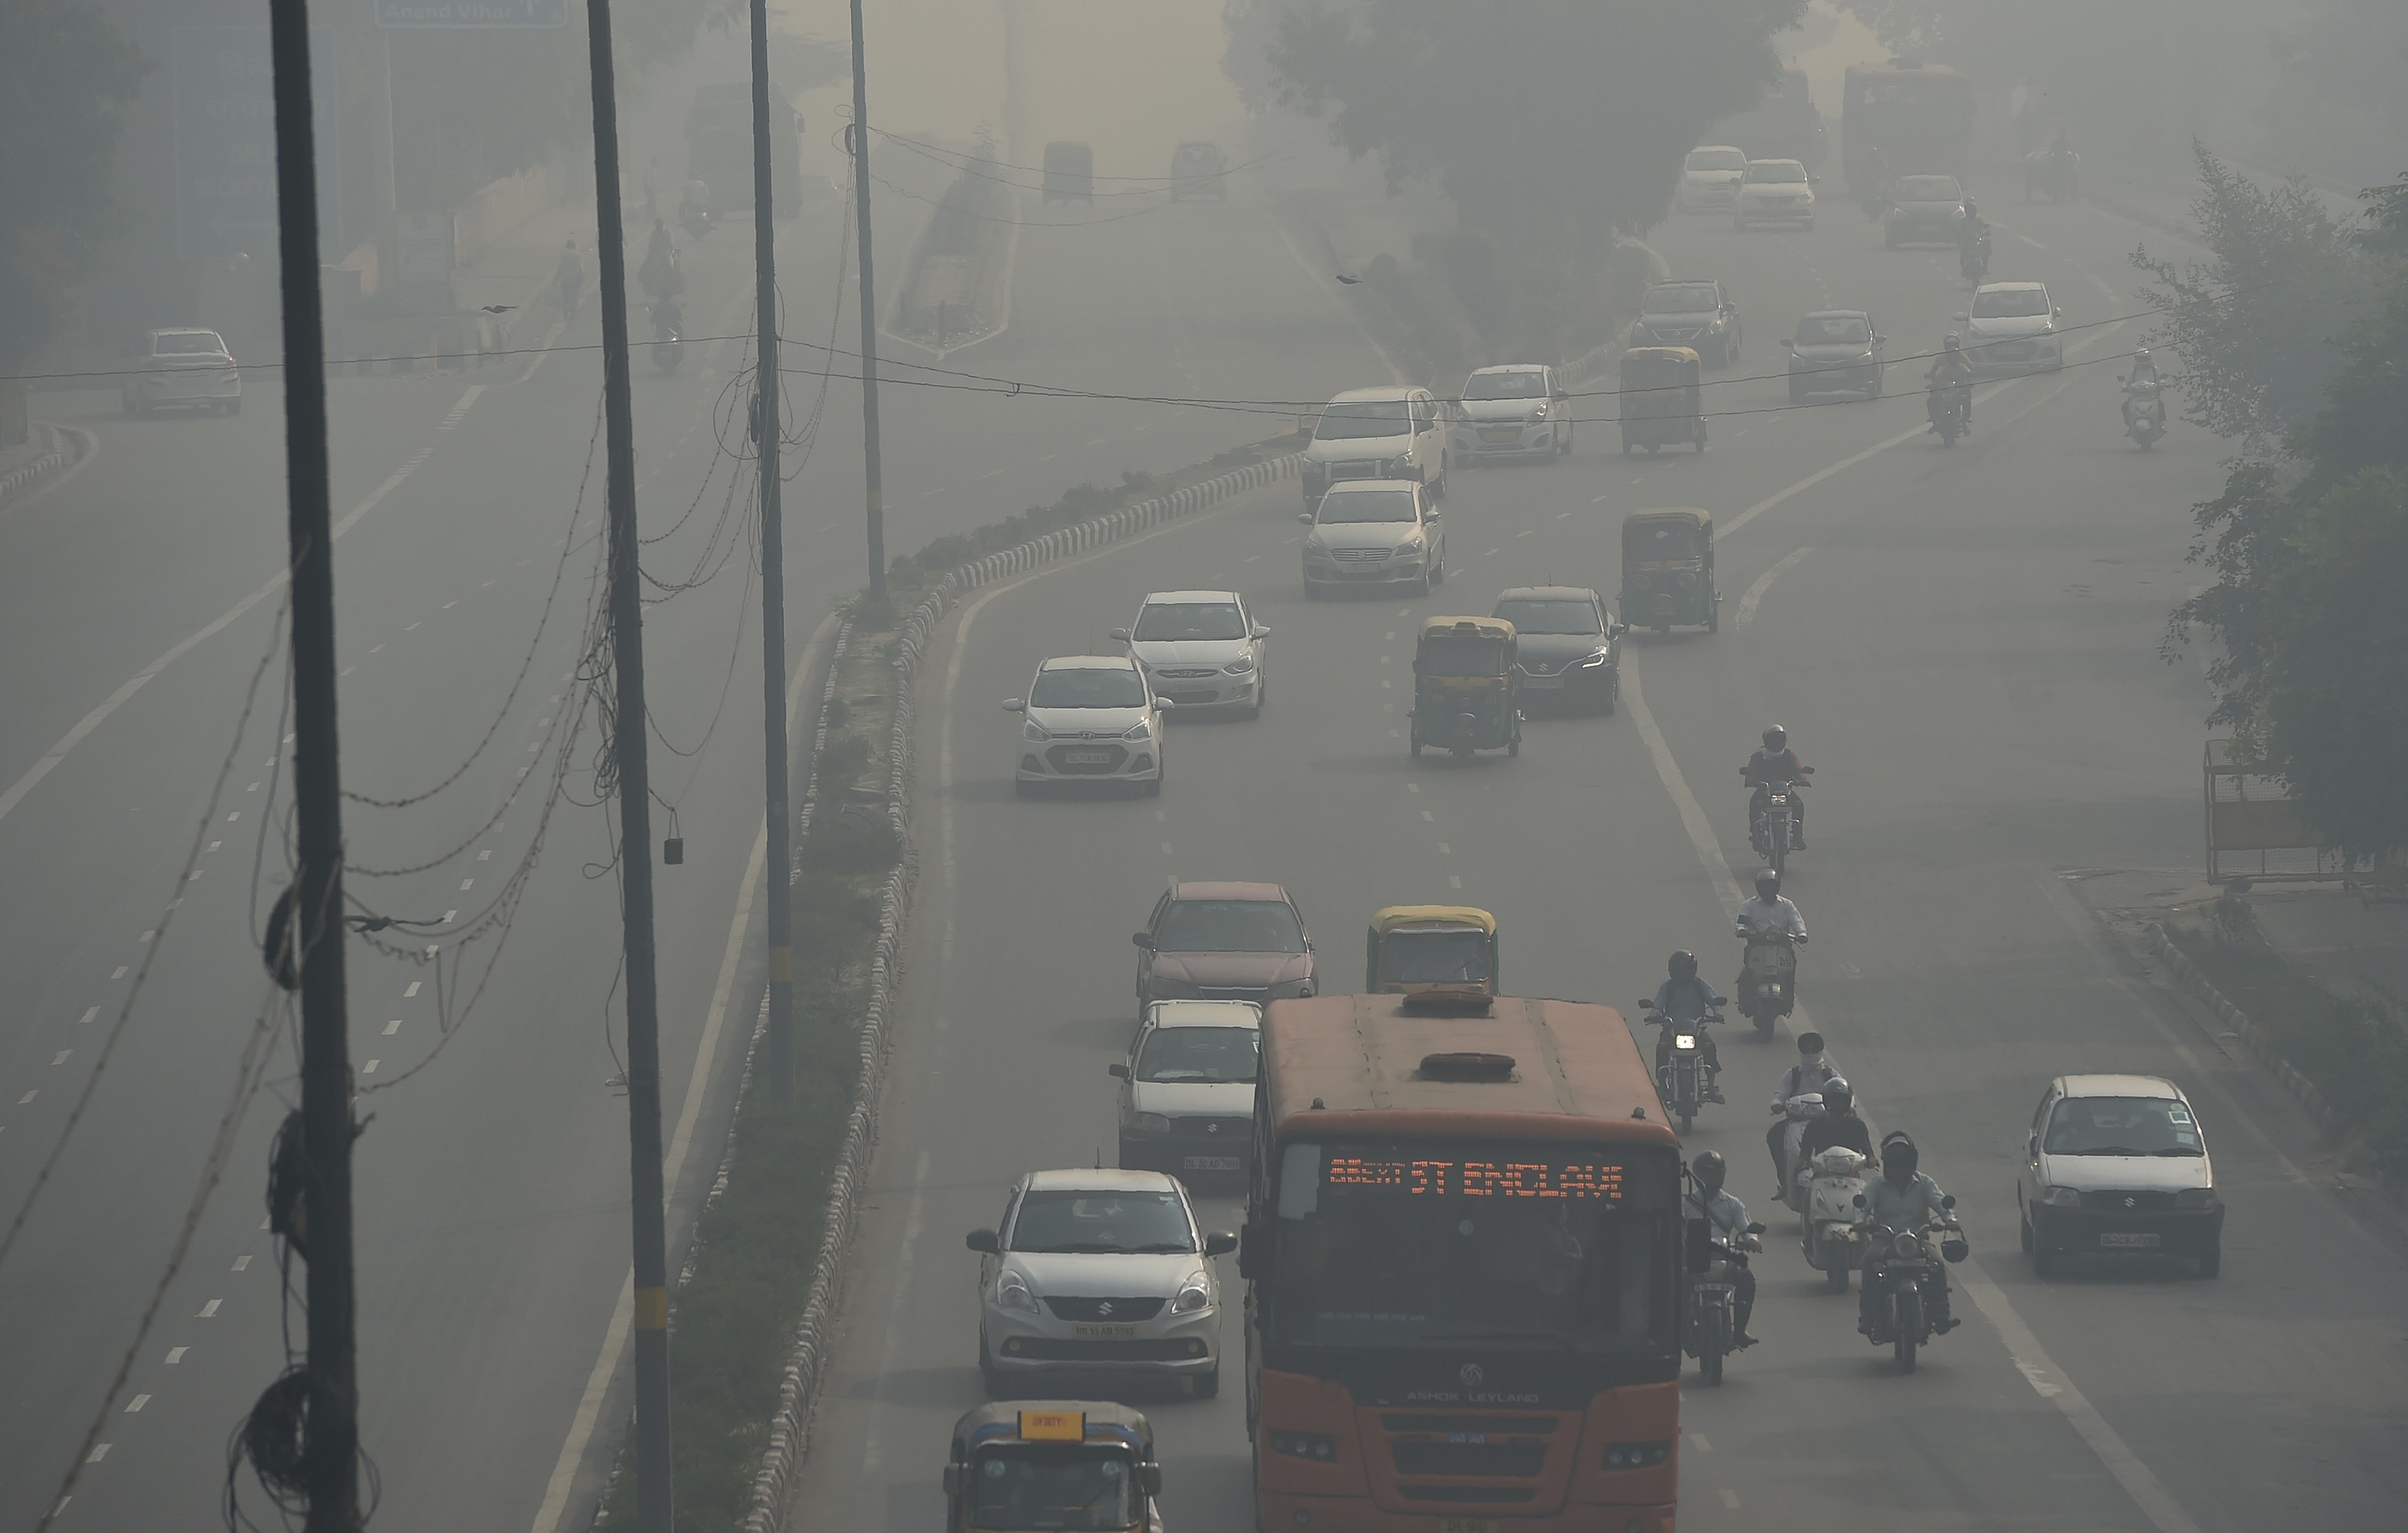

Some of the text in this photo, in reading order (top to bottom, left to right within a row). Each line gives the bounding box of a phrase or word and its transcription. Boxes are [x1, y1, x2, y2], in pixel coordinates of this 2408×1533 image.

[385, 3, 513, 19] Anand Vihar
[1407, 1391, 1540, 1403] ASHOK LEYLAND
